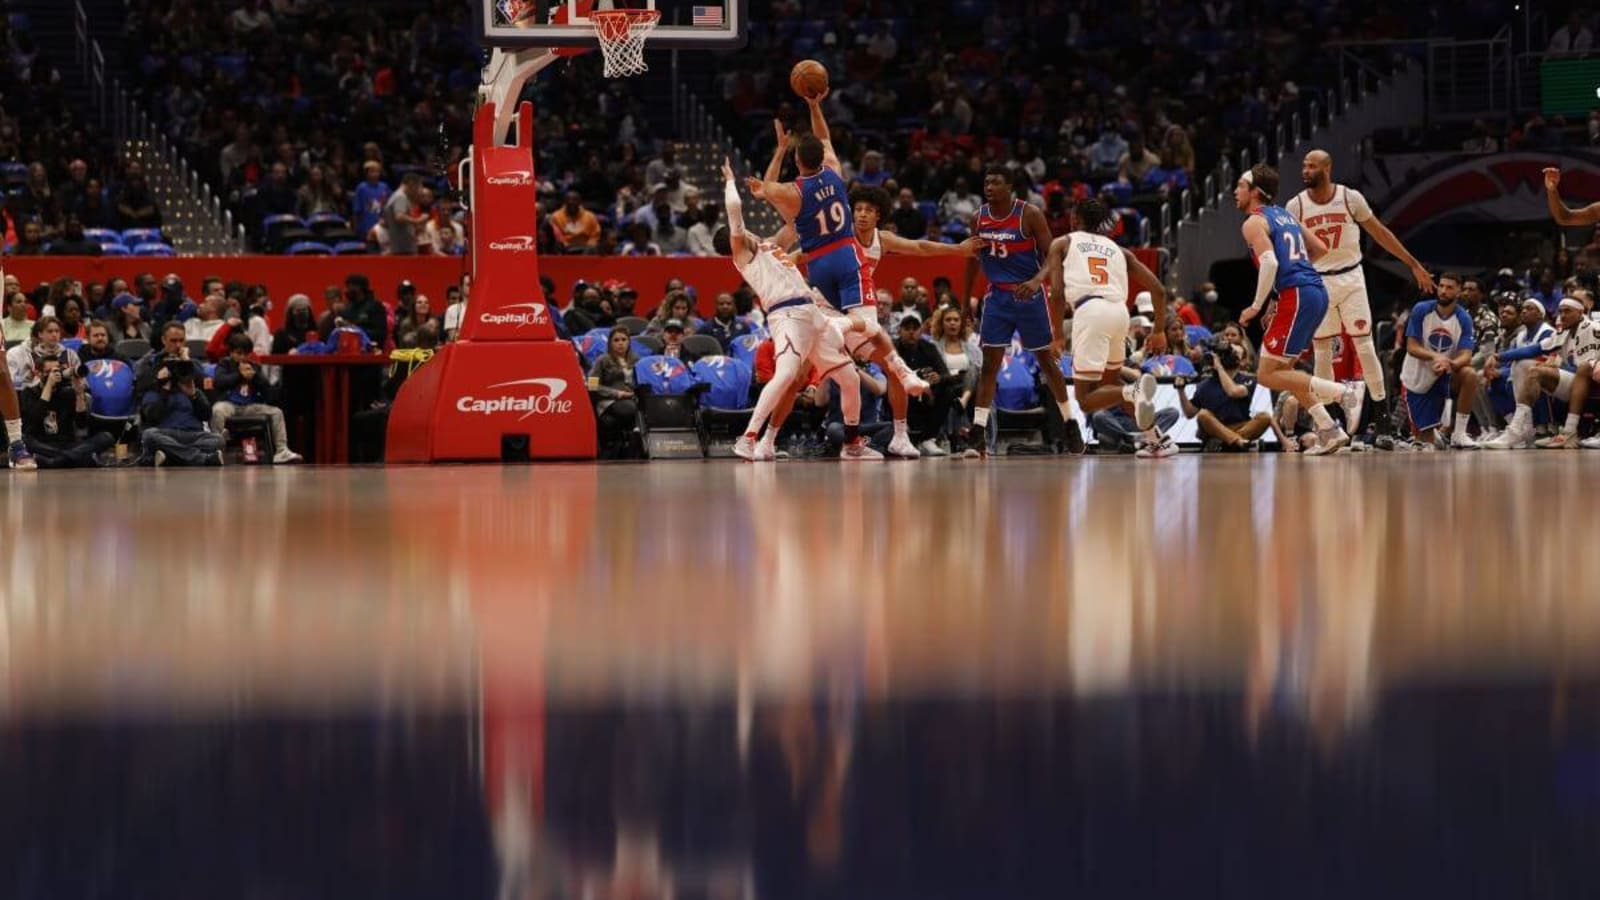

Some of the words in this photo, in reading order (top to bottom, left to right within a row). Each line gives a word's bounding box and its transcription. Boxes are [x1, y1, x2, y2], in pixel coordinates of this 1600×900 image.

[815, 201, 845, 236] 19
[990, 241, 1009, 259] 13
[1087, 256, 1109, 286] 5
